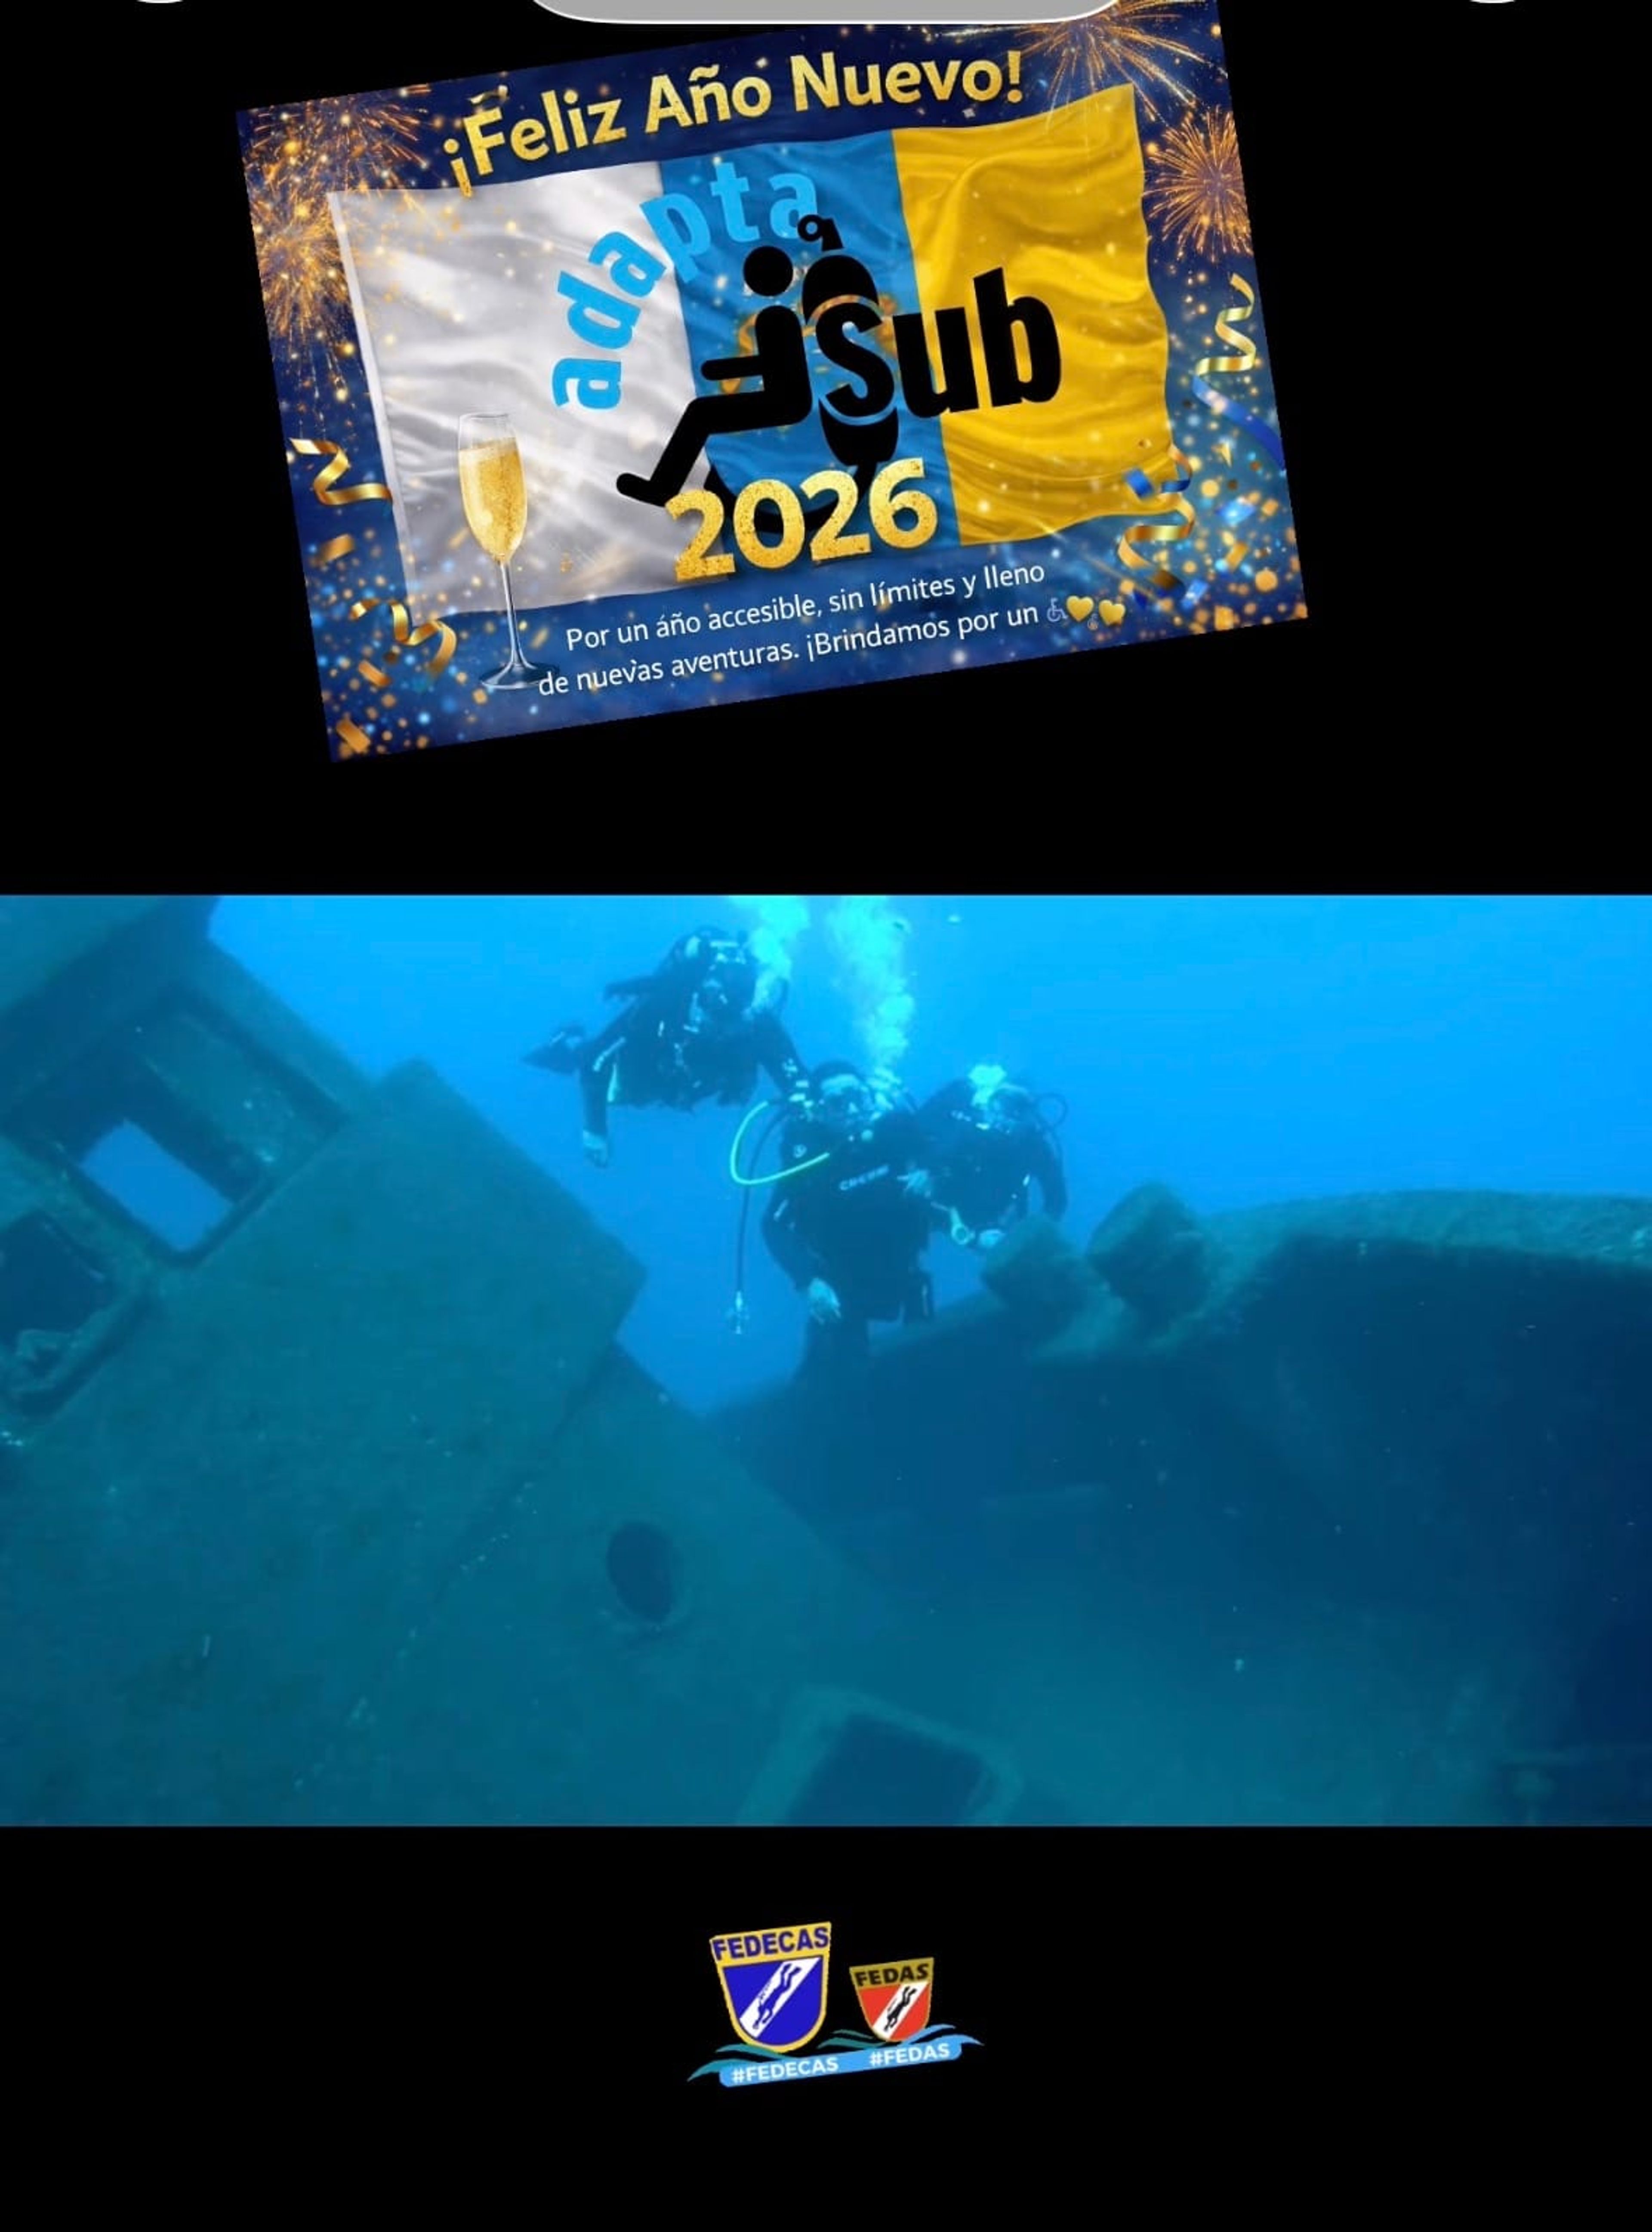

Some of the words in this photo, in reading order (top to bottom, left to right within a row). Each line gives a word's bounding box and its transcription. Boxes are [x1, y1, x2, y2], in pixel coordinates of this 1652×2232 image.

[443, 89, 627, 198] ¡Feliz
[645, 64, 772, 133] Año
[790, 50, 1023, 112] Nuevo!
[552, 162, 818, 410] adapta
[665, 457, 938, 583] 2026
[538, 672, 570, 696] de
[672, 641, 800, 677] aventuras.
[807, 619, 950, 662] ¡Brindamos
[957, 610, 999, 640] por
[1007, 606, 1039, 627] un
[566, 628, 610, 651] Por
[617, 622, 649, 644] un
[708, 593, 823, 631] accesible,
[829, 588, 864, 613] sin
[870, 576, 955, 606] límites
[962, 574, 977, 598] y
[983, 565, 1045, 590] lleno
